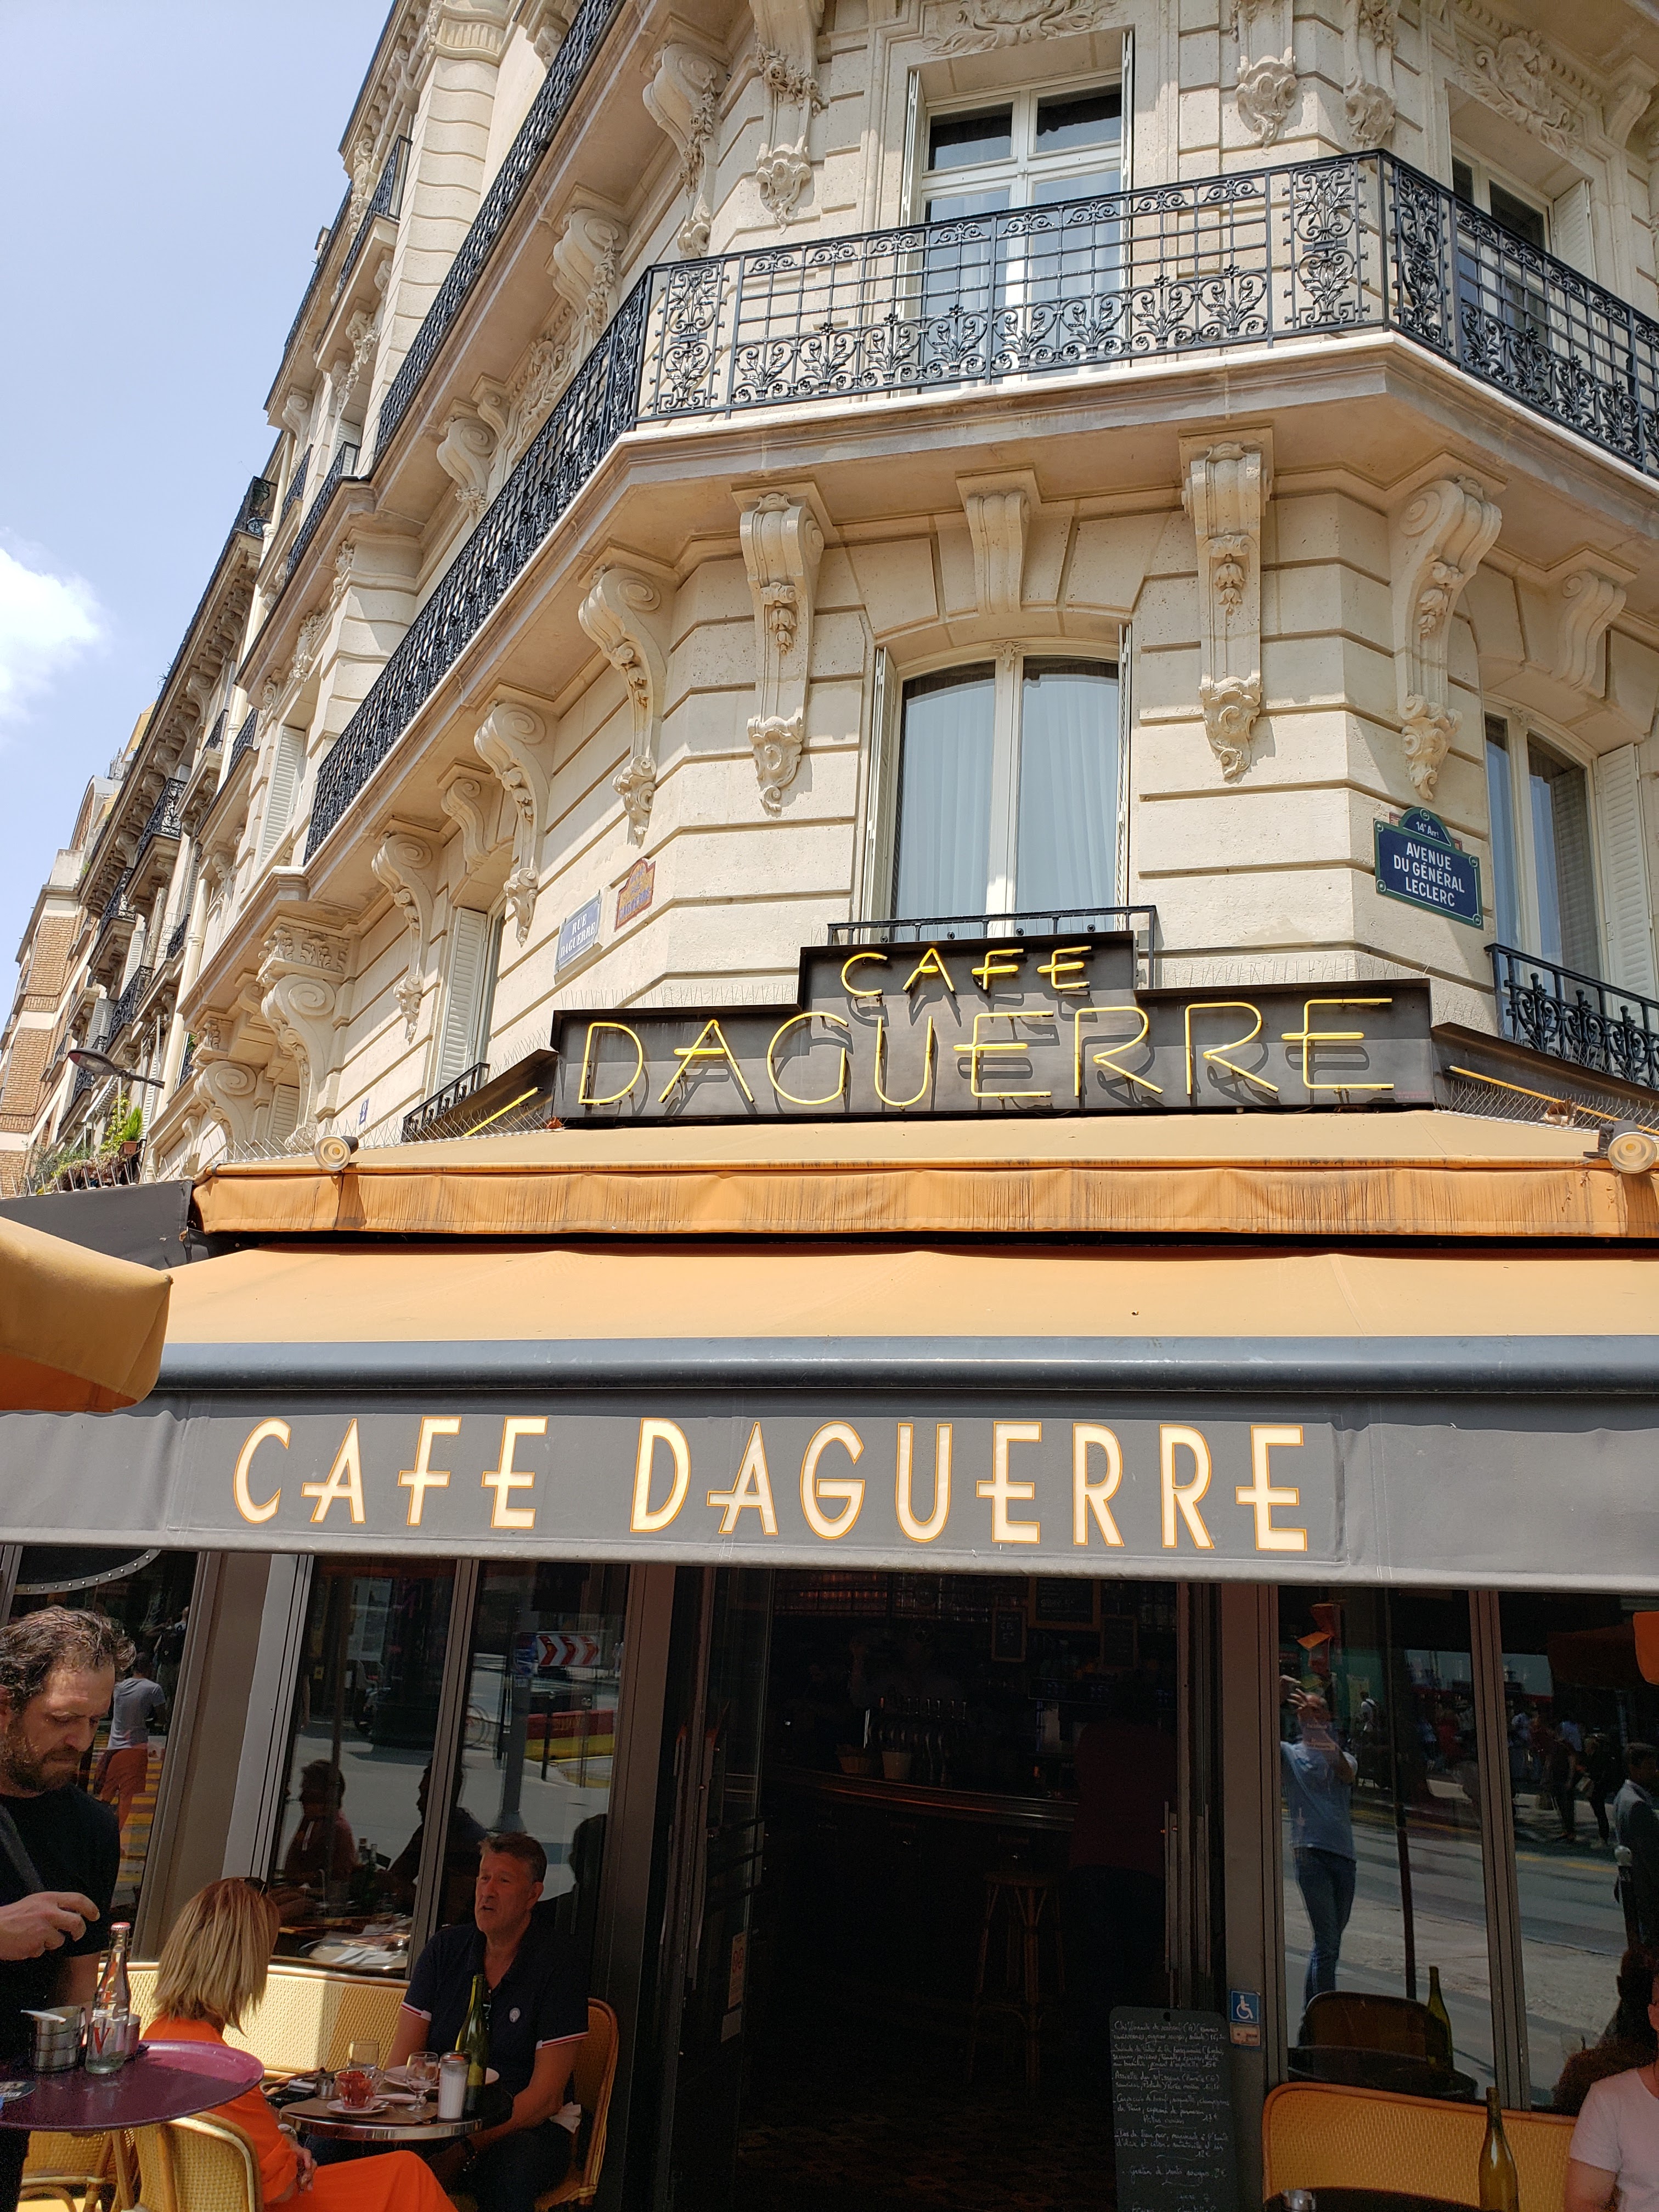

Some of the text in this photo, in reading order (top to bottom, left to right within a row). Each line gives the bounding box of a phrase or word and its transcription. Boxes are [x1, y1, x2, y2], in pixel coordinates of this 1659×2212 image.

[1393, 854, 1465, 893] DU GÉNÉRAL
[1406, 842, 1452, 871] AVENUE
[1406, 876, 1455, 907] LECLERC
[560, 922, 596, 958] DAGUERRE
[572, 913, 588, 936] RUE
[840, 946, 1092, 996] CAFE
[578, 997, 1395, 1107] DAGUERRE
[233, 1415, 1308, 1551] CAFE DAGUERRE
